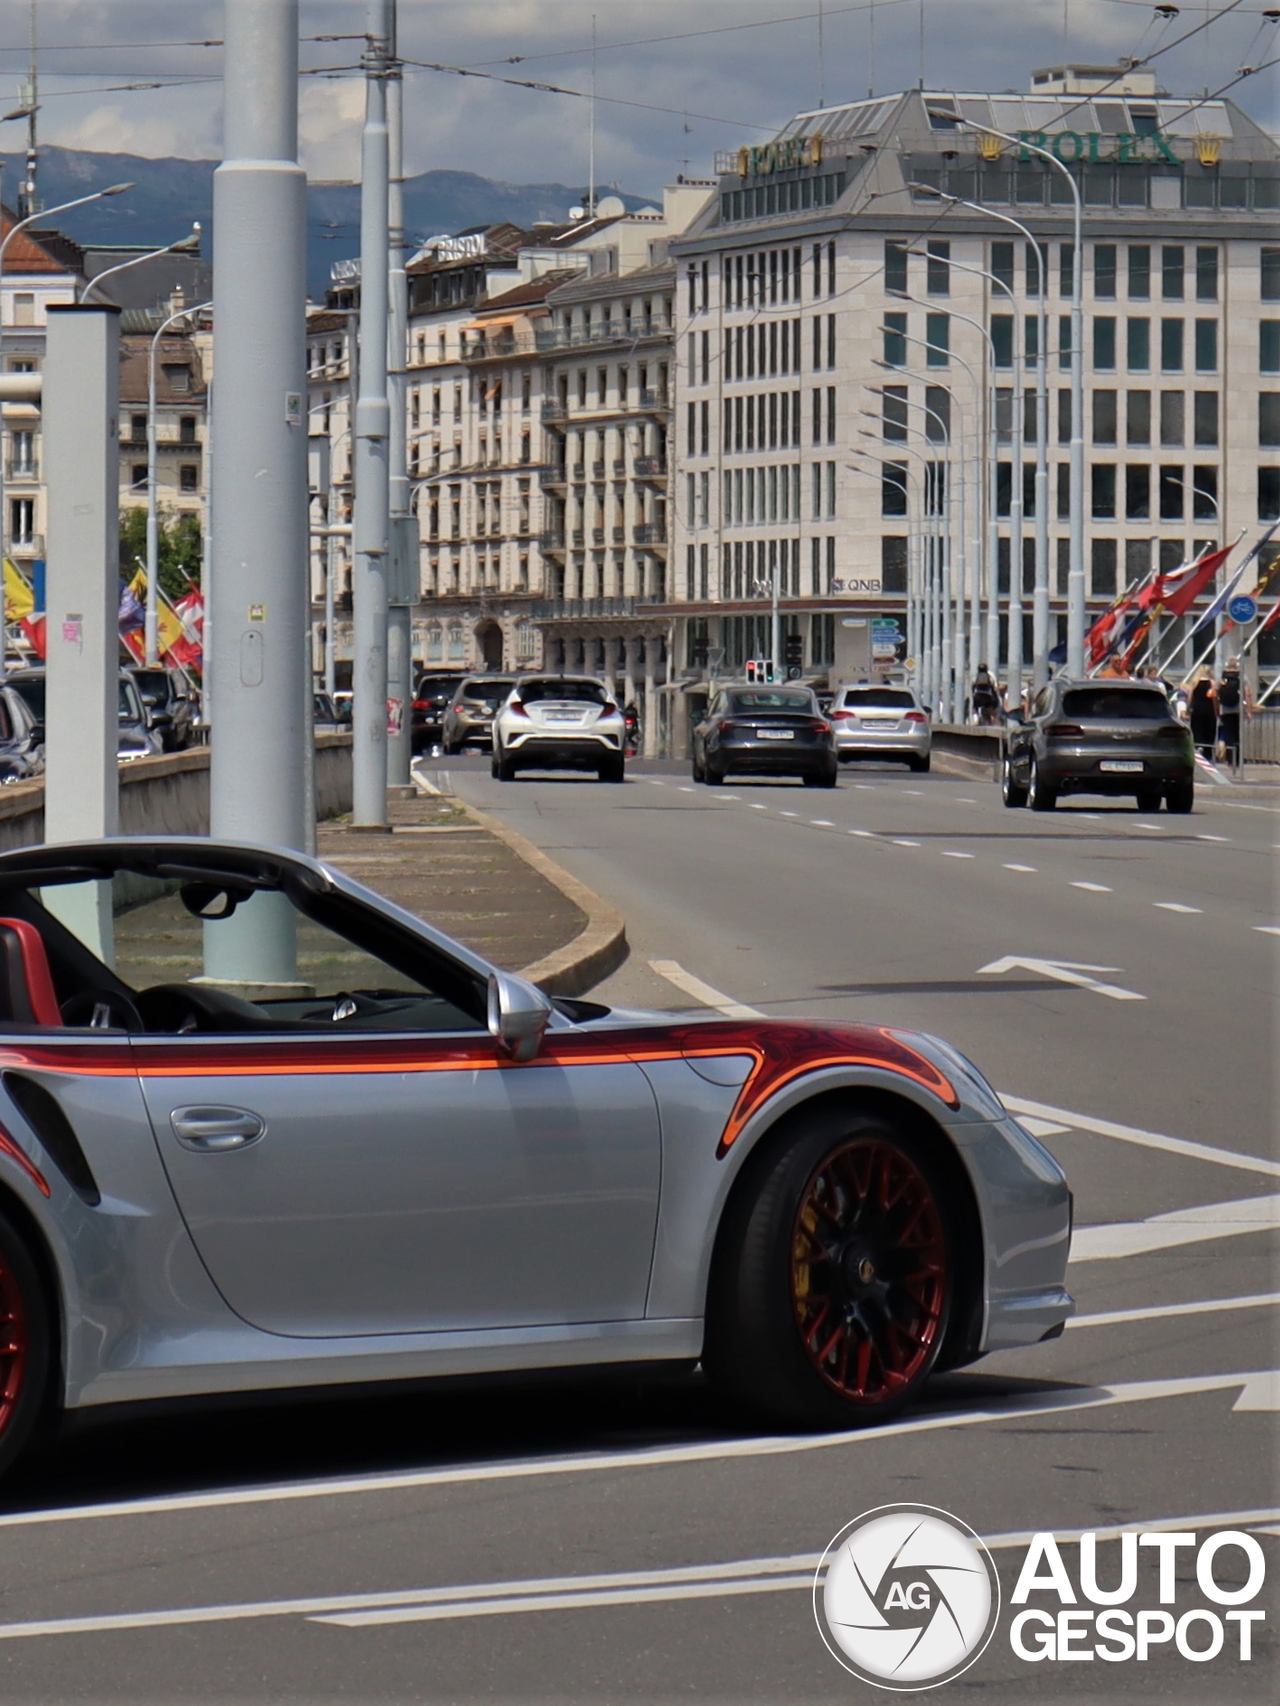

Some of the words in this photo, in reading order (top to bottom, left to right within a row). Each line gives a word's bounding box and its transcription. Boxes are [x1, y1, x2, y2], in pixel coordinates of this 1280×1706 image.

[750, 136, 808, 177] ROLEX
[1017, 130, 1181, 165] ROLEX
[438, 233, 487, 262] BRISTOL
[848, 579, 881, 592] QNB
